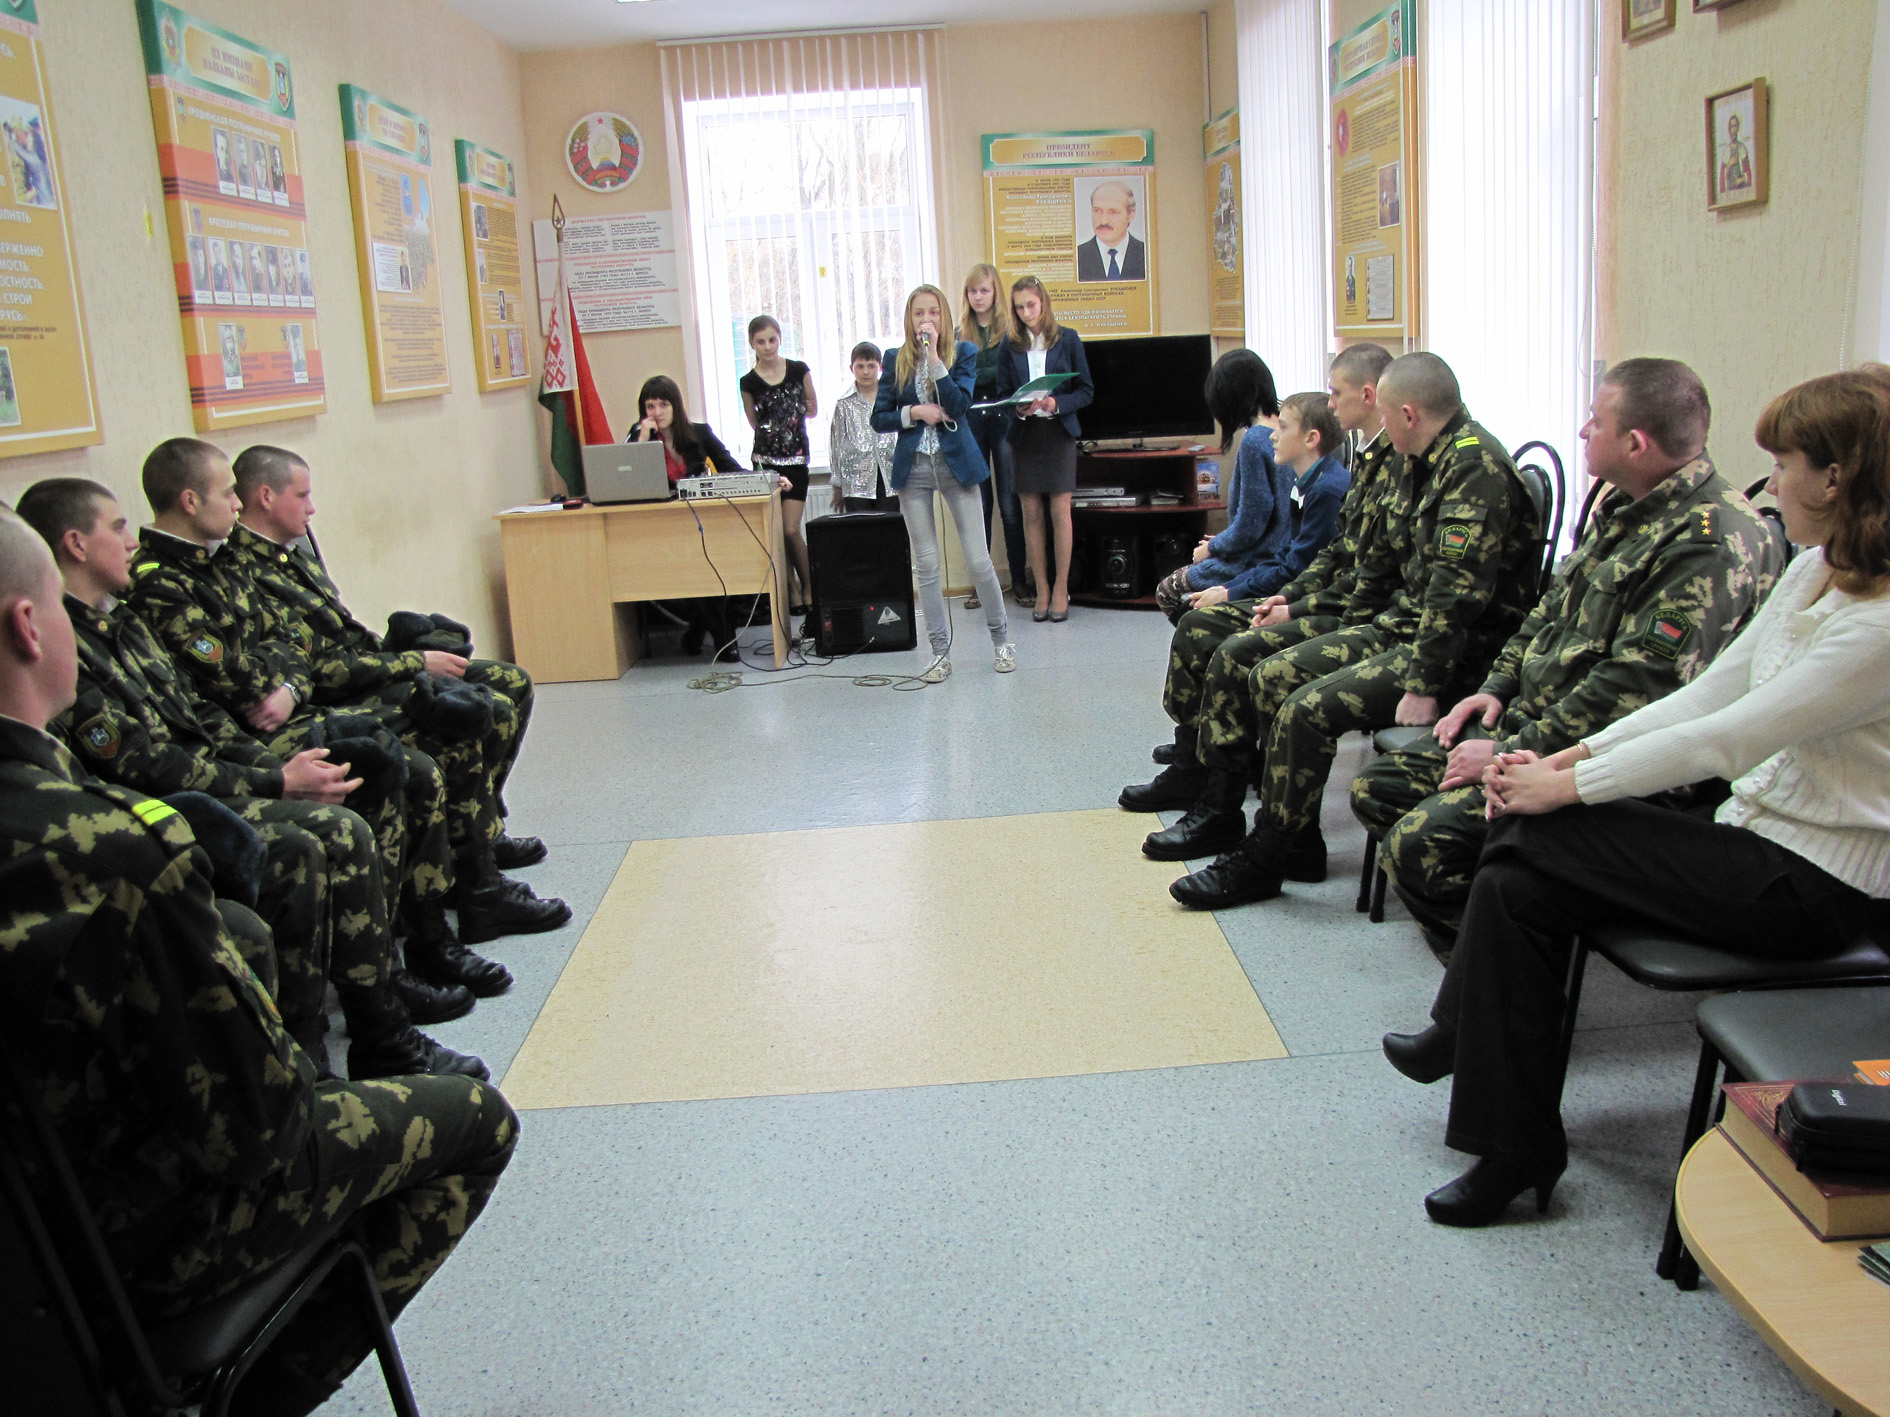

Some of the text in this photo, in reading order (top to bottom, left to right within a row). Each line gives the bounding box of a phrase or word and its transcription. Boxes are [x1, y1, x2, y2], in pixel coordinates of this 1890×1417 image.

[1046, 143, 1091, 151] ПРЕЗИДЕНТ
[1022, 150, 1115, 159] РЕСПУБЛИКИ БЕЛАРУСЬ
[4, 290, 33, 305] СТРОЙ
[1655, 611, 1688, 630] БЕЛАРУСЬ
